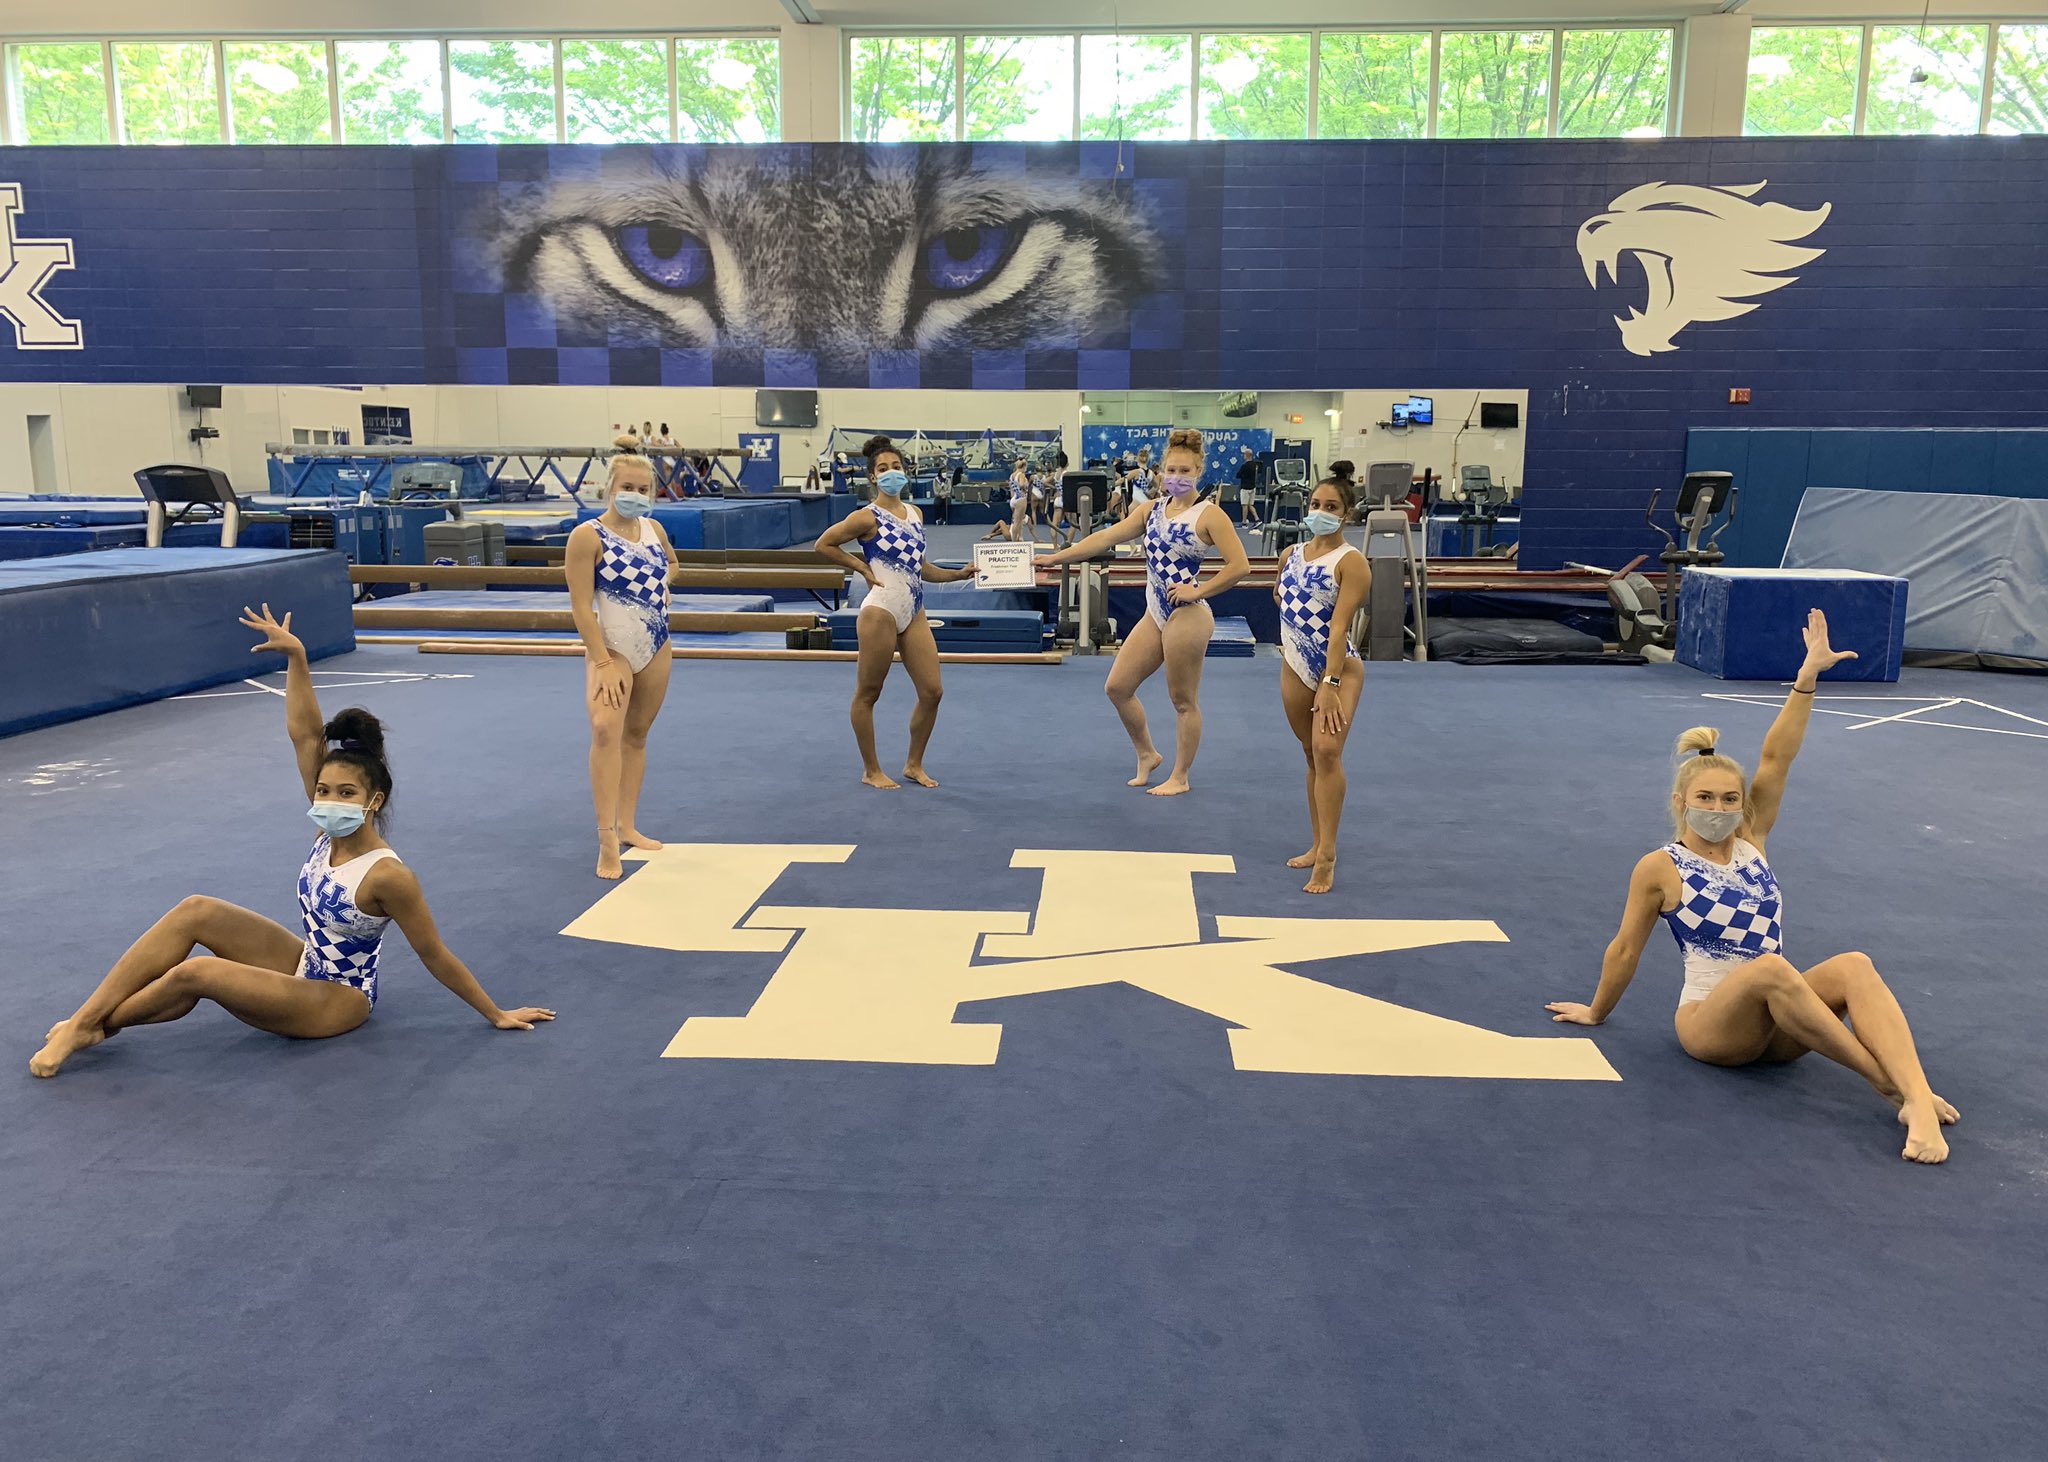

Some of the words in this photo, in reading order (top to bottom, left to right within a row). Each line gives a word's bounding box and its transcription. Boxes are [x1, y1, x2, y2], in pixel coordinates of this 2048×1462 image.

[1167, 522, 1195, 546] UK
[1302, 565, 1332, 591] UK
[315, 871, 355, 926] UK
[558, 843, 1622, 1081] UK
